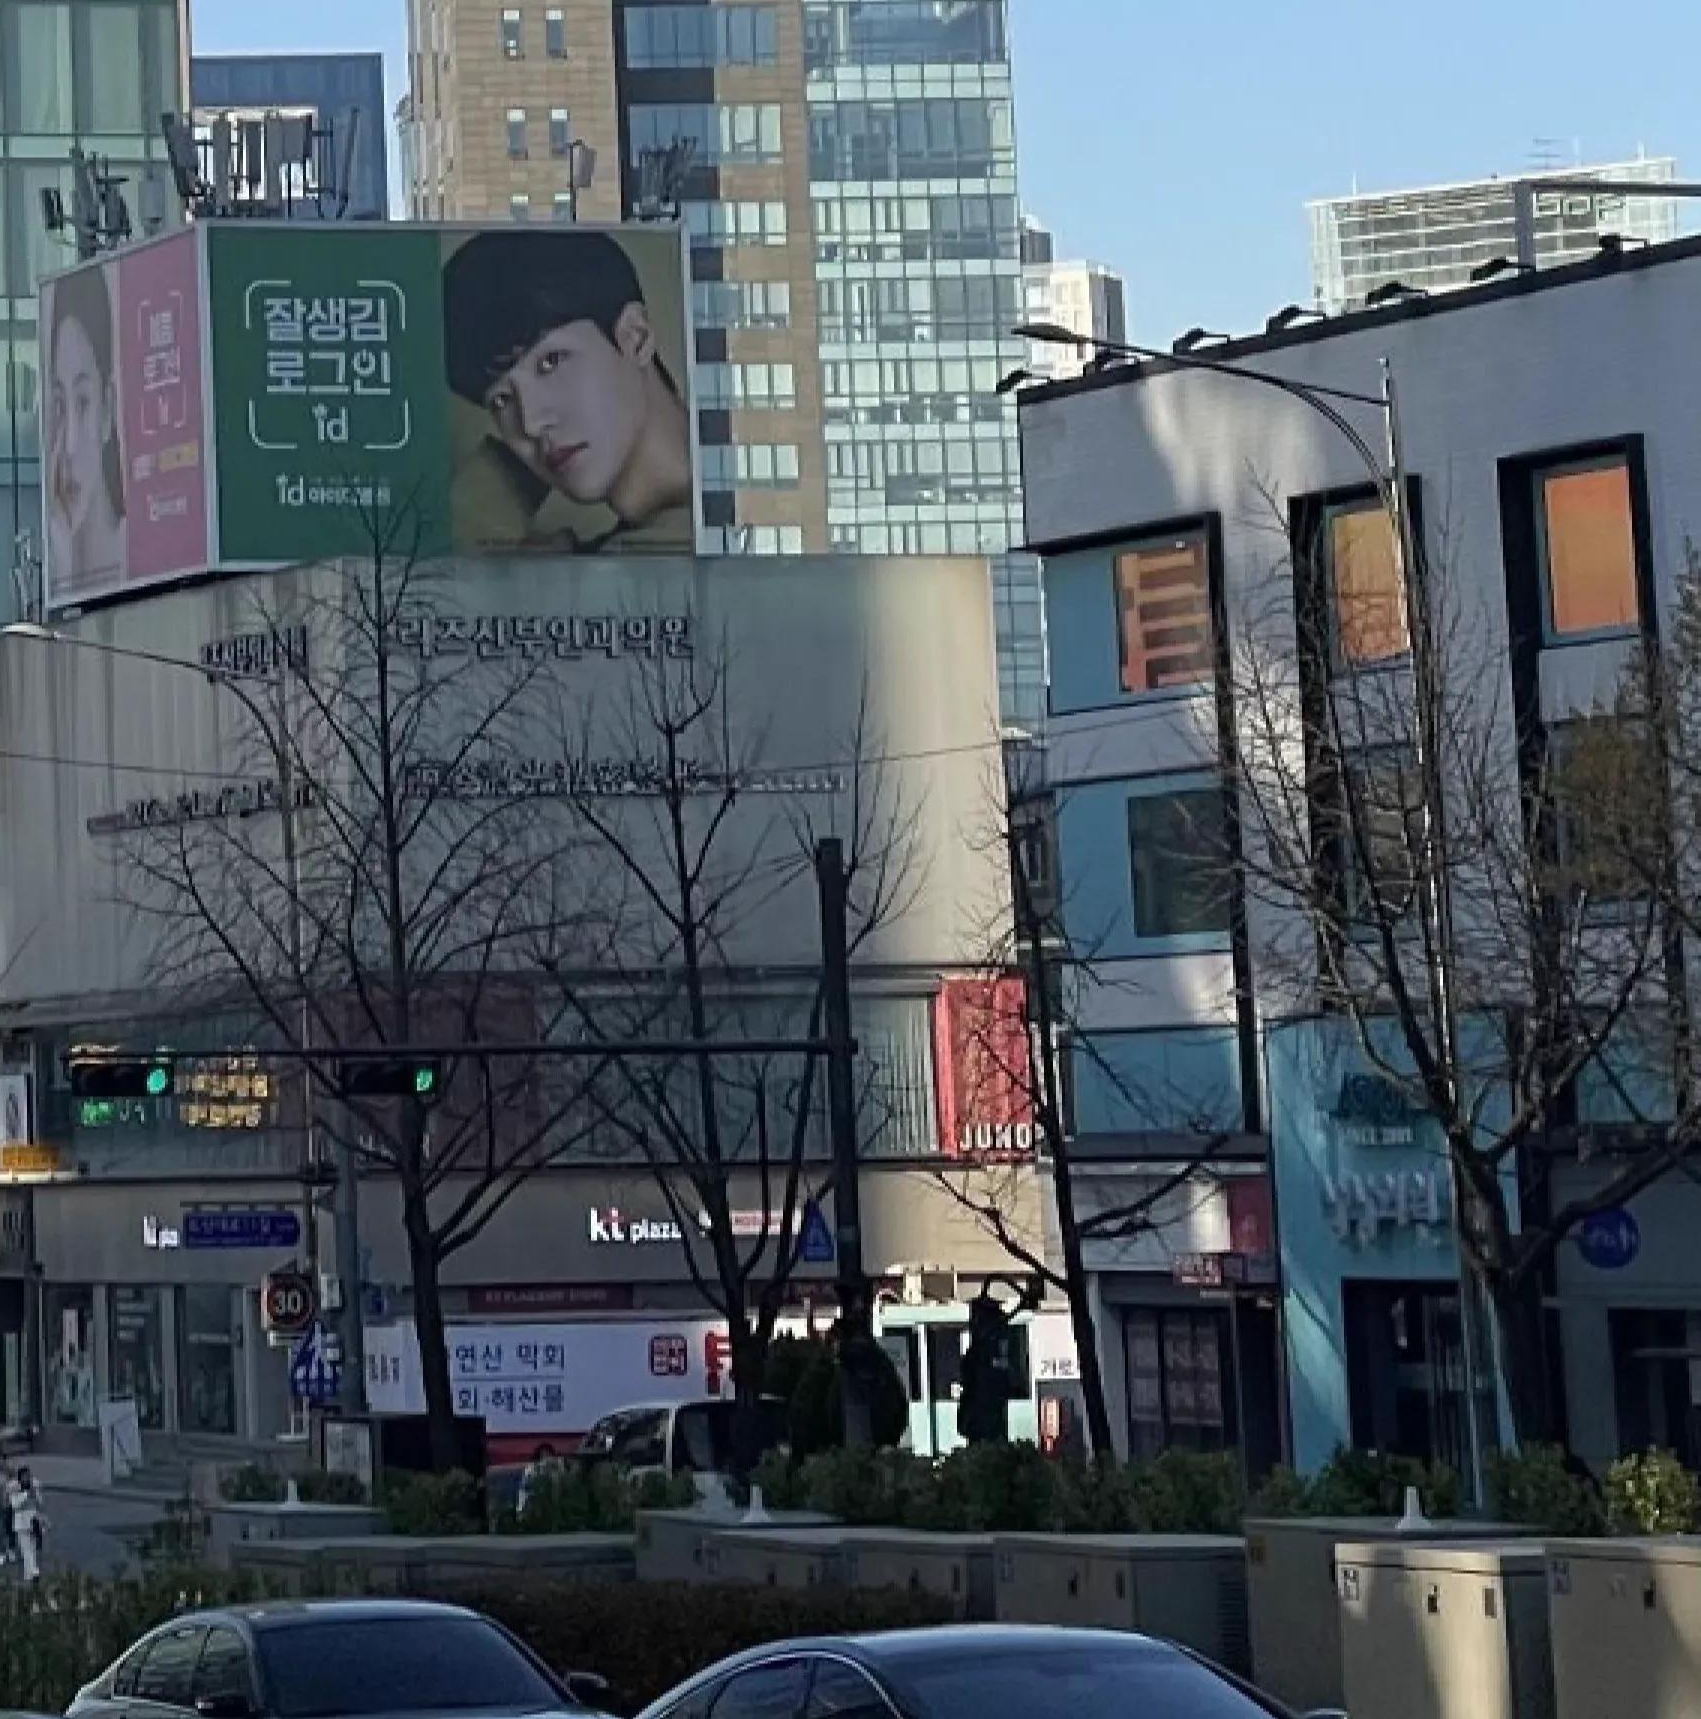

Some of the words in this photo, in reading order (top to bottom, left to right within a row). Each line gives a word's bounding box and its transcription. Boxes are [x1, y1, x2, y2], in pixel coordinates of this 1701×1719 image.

[264, 297, 388, 342] 잘생김
[265, 349, 391, 395] 로그인
[311, 403, 349, 443] id
[590, 1207, 624, 1242] kt
[275, 1290, 301, 1316] 30
